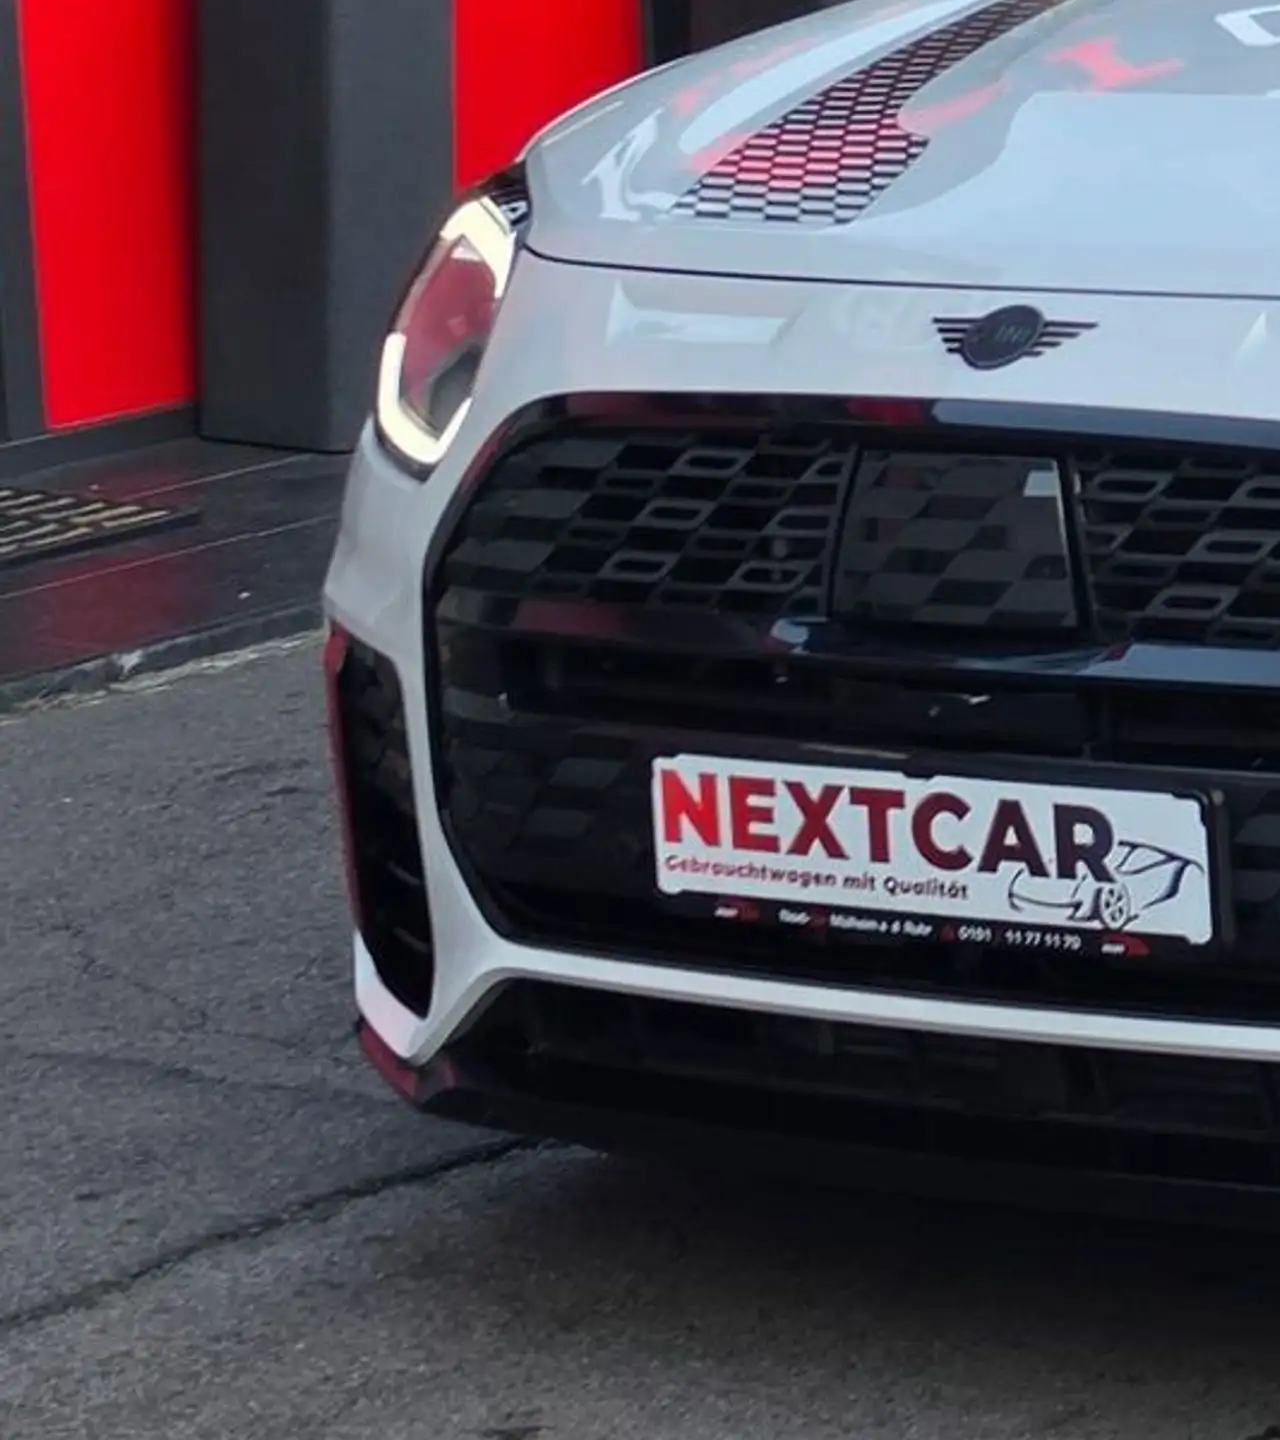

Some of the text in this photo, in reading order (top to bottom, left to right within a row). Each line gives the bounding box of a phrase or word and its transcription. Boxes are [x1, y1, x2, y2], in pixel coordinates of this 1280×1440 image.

[660, 768, 1119, 884] NEXTCAR
[664, 854, 837, 889] Gebrauchtwagen
[842, 869, 876, 892] mit
